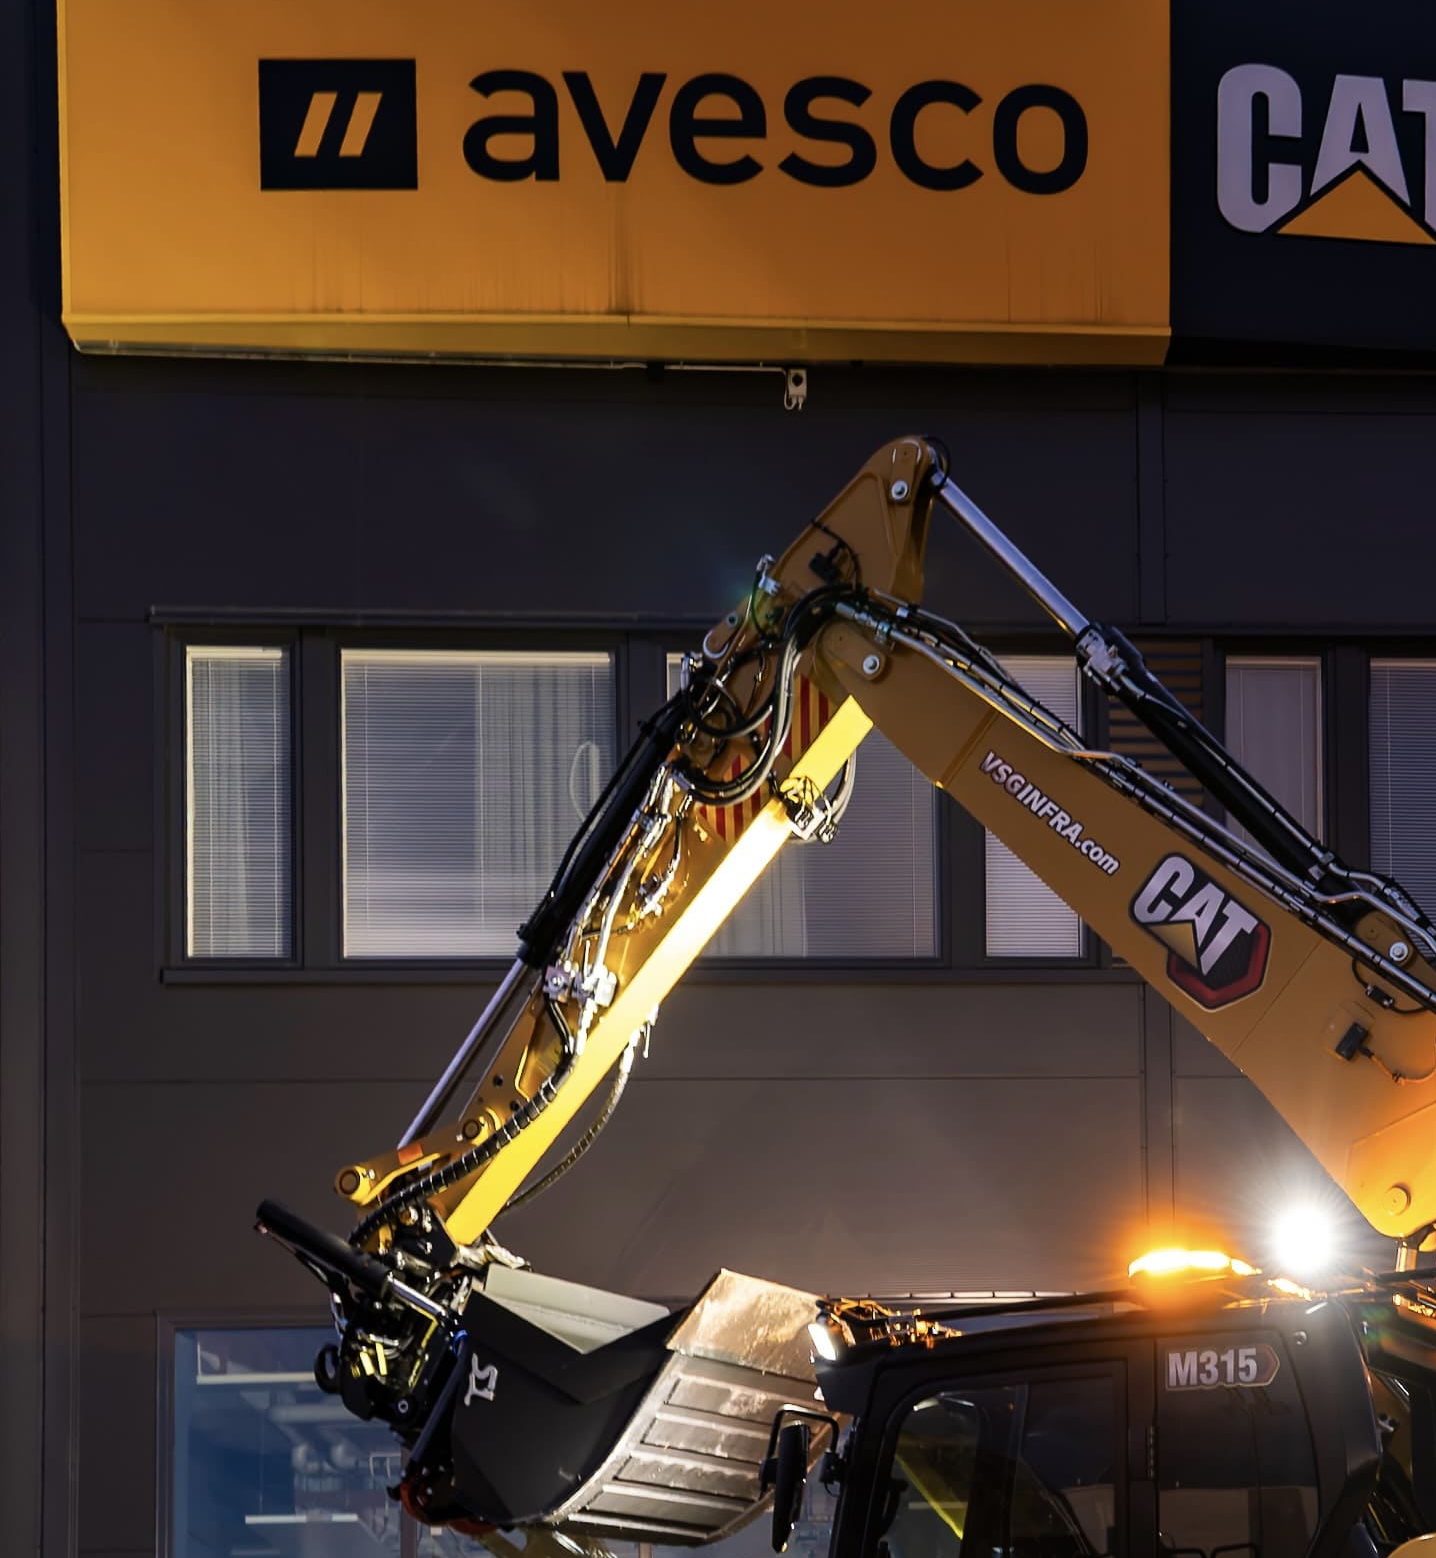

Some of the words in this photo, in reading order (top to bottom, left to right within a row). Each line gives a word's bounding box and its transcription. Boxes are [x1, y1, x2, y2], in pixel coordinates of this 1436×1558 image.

[460, 66, 1090, 196] avesco
[980, 750, 1121, 876] VSGINFRA.com
[1133, 855, 1258, 975] CAT
[1168, 1348, 1257, 1387] M315
